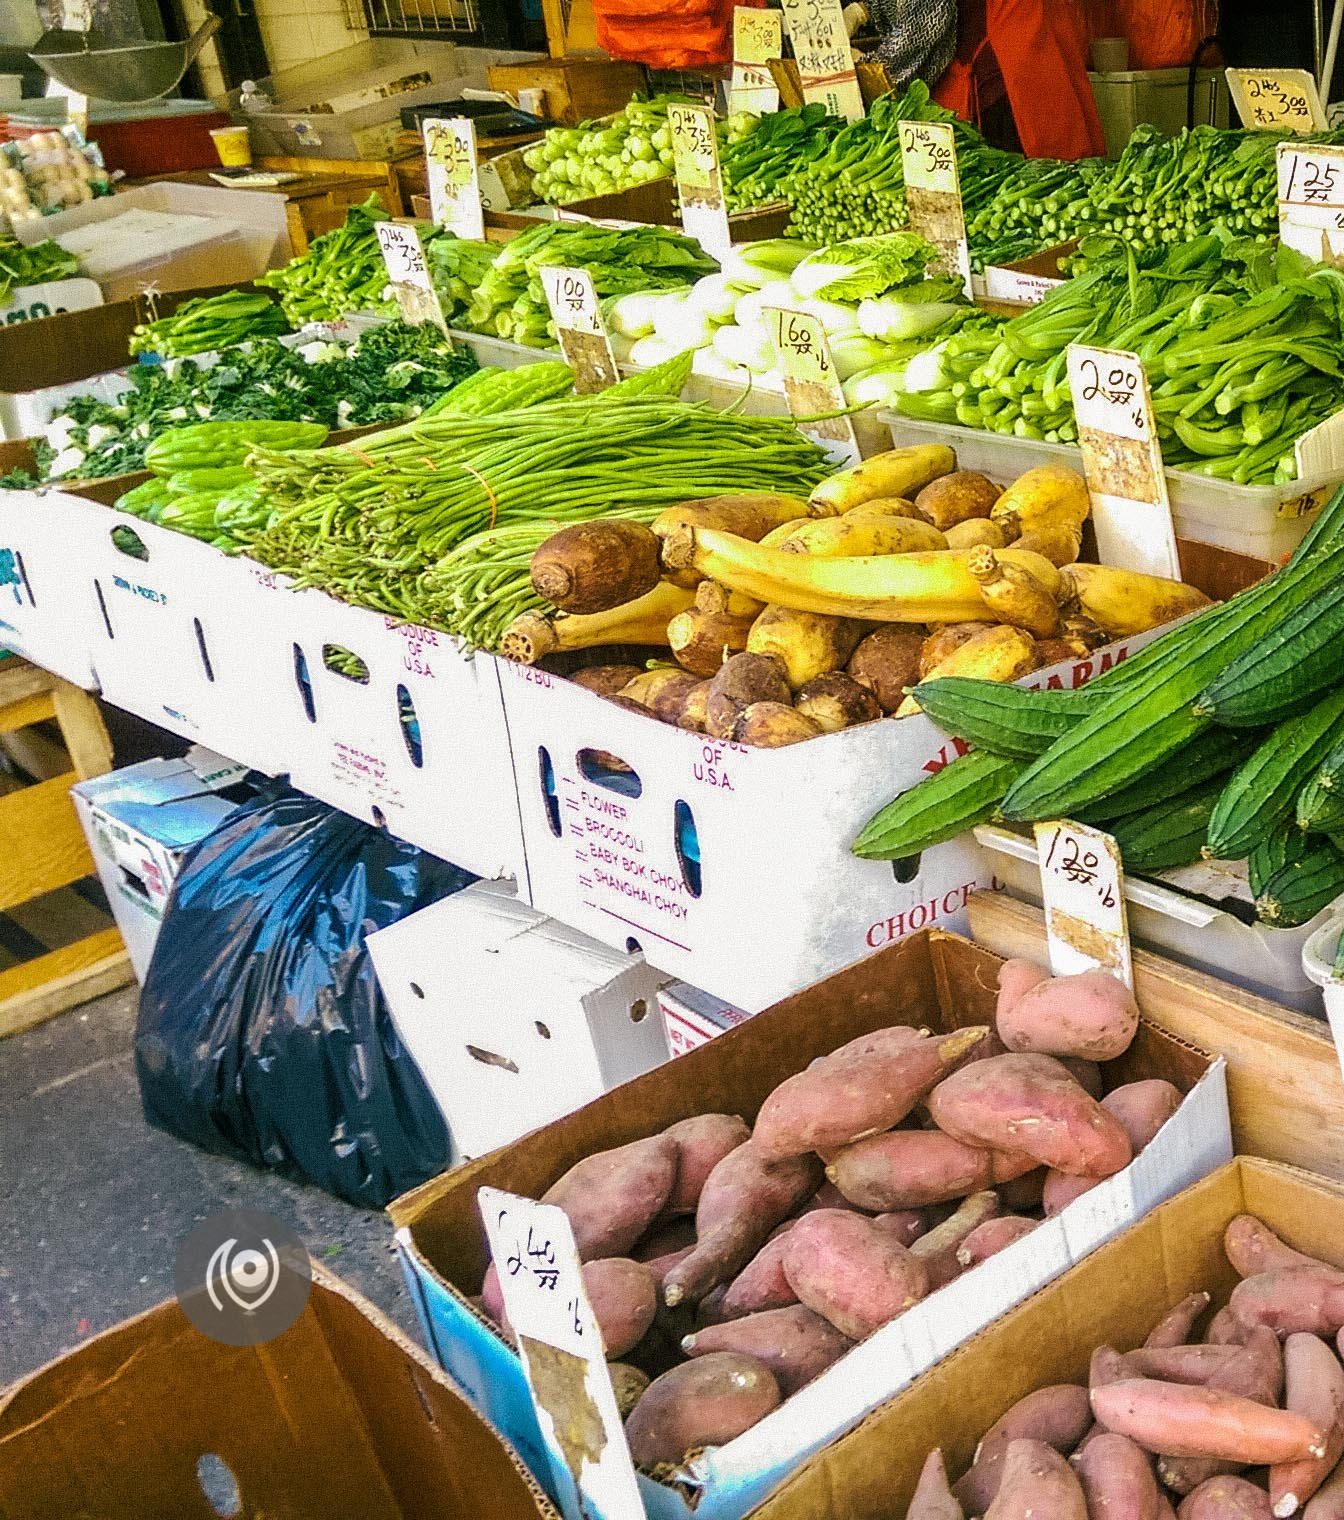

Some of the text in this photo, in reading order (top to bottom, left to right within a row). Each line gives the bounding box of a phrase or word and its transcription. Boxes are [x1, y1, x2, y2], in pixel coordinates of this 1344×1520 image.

[1029, 646, 1129, 690] ARM
[703, 745, 722, 766] OF
[693, 763, 735, 791] U.S.A.
[581, 791, 628, 820] FLOWER
[585, 817, 645, 853] BROCCOLI
[593, 868, 688, 920] SHANGHAI CHOY
[622, 859, 646, 877] BOK
[650, 869, 686, 895] CHOY
